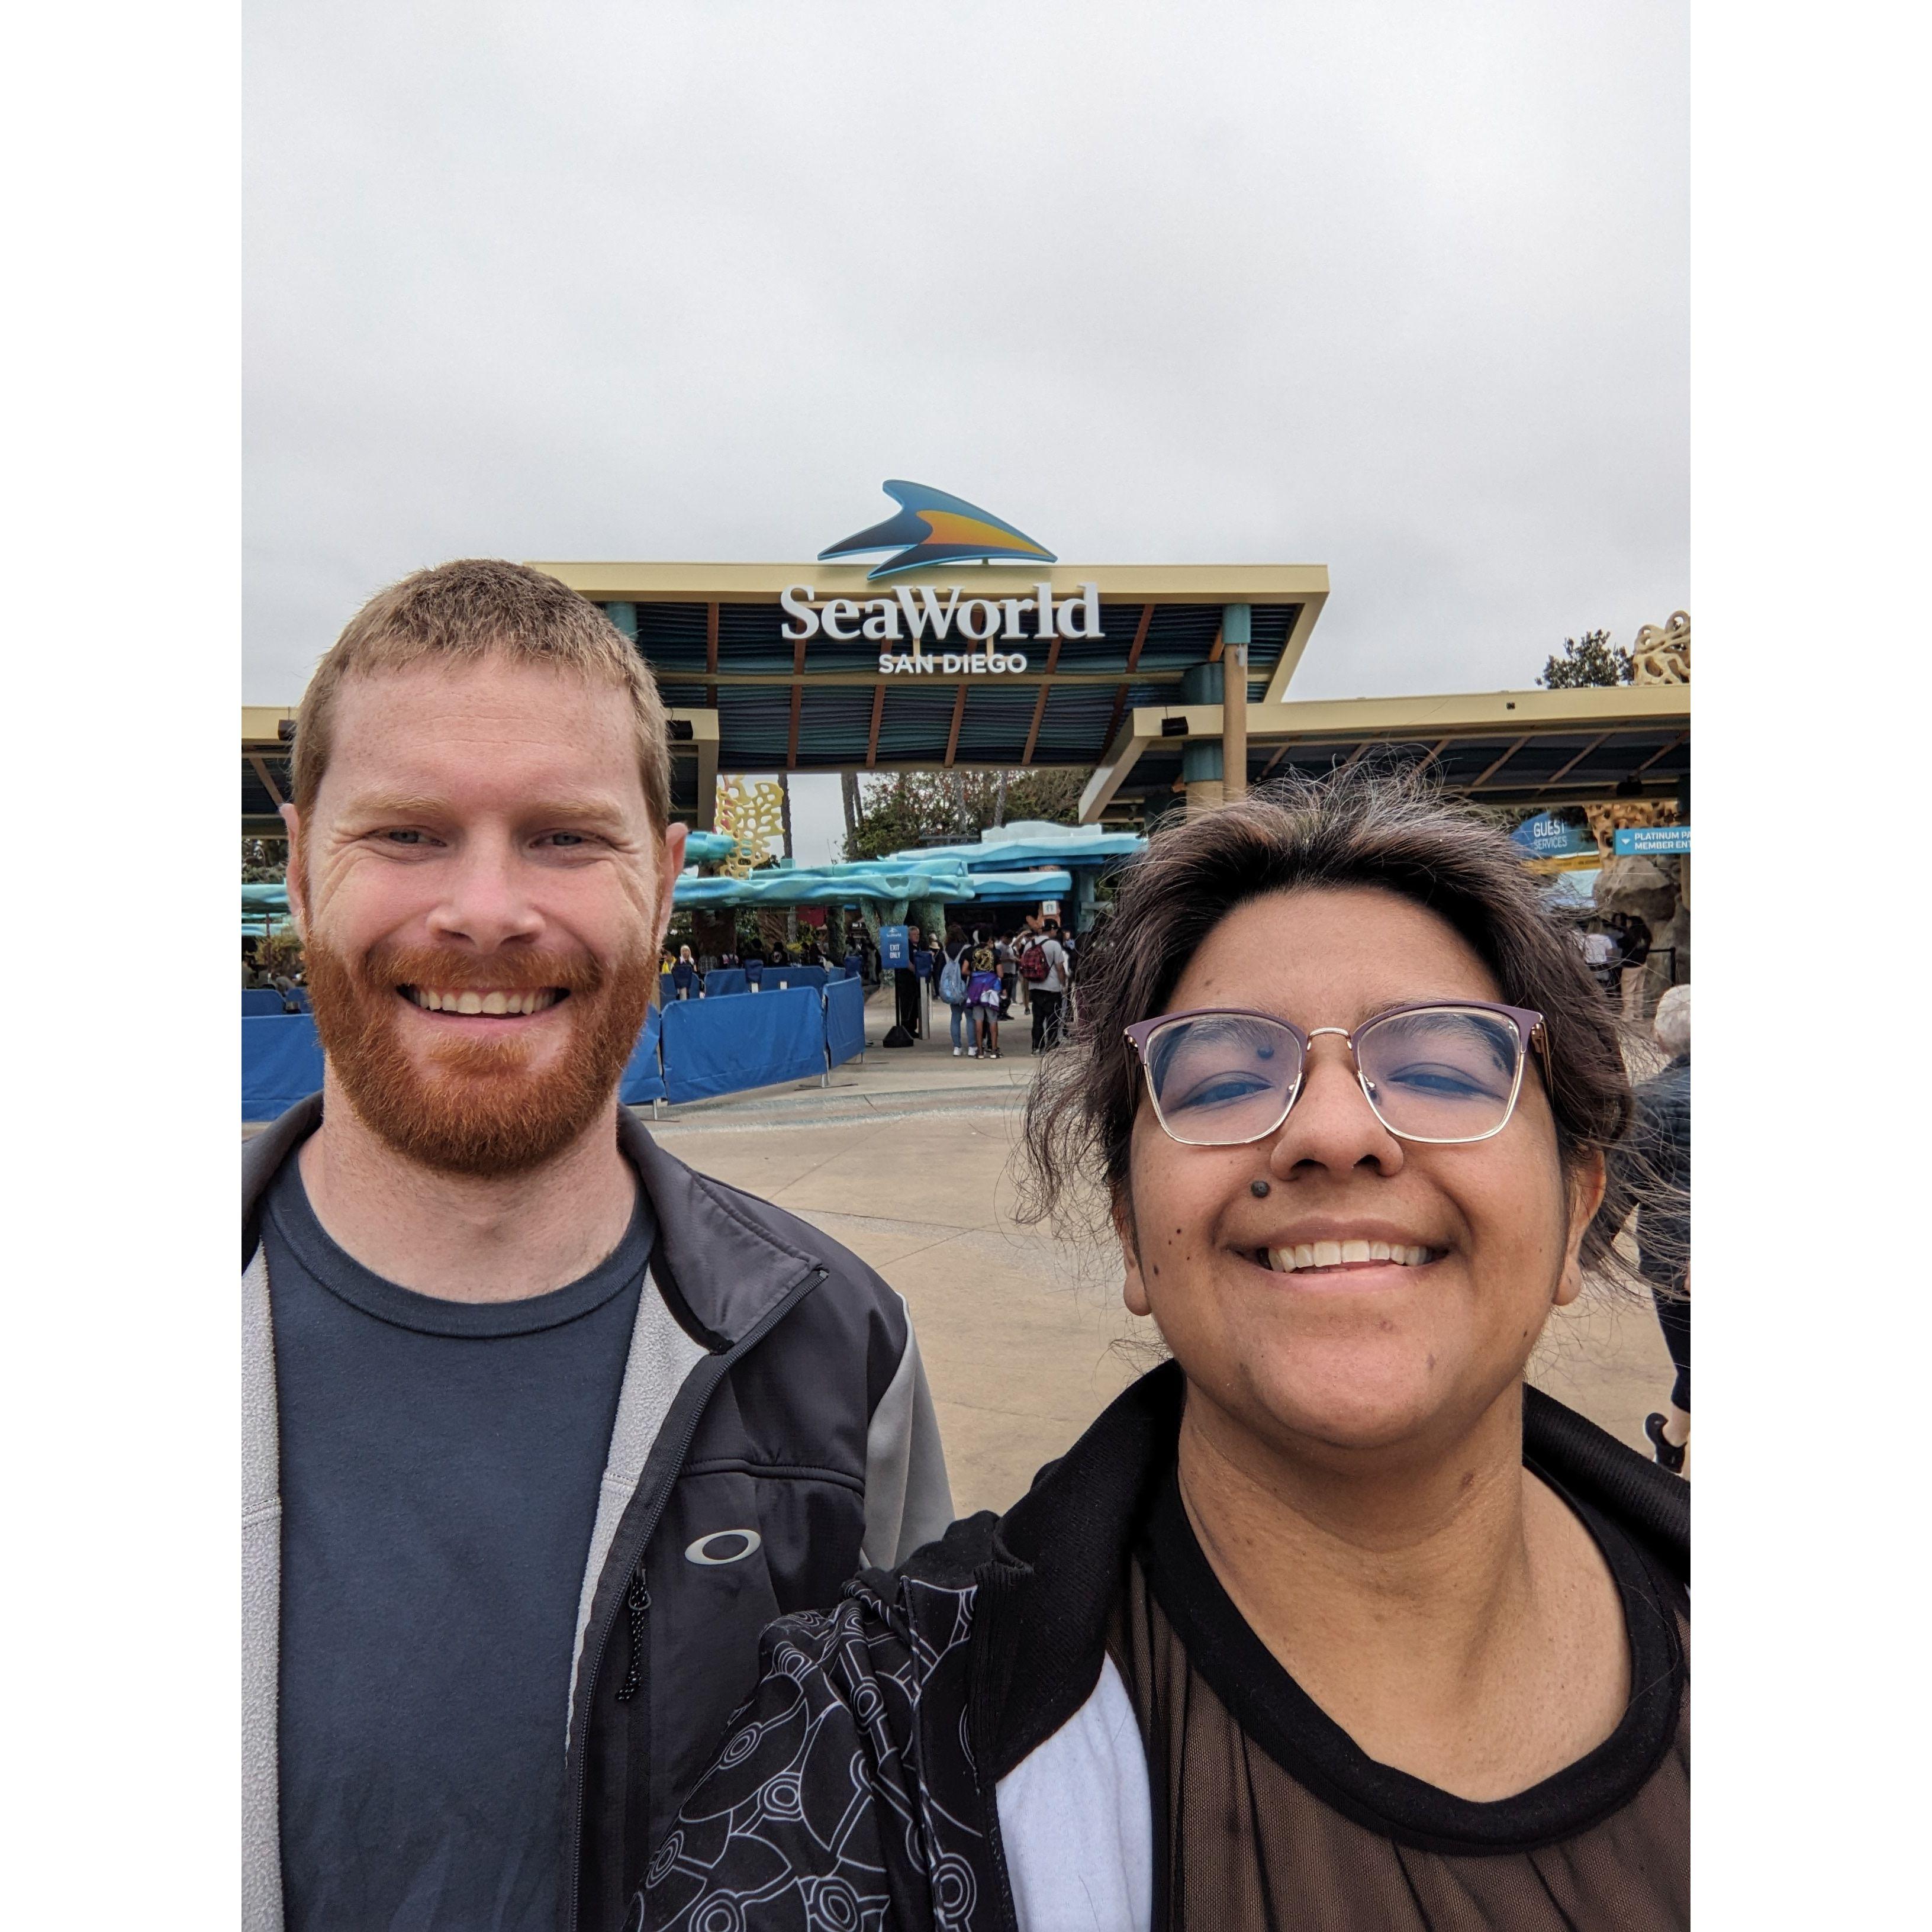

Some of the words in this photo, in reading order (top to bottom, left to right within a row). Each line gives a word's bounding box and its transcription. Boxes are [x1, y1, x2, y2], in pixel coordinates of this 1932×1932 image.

[780, 582, 1105, 640] SeaWorld
[878, 653, 934, 674] SAN
[942, 653, 1028, 674] DIEGO
[1534, 820, 1564, 838] GUEST
[1634, 832, 1680, 841] PLATINUM
[1534, 836, 1567, 850] SERVICES
[1634, 841, 1674, 851] MEMBER
